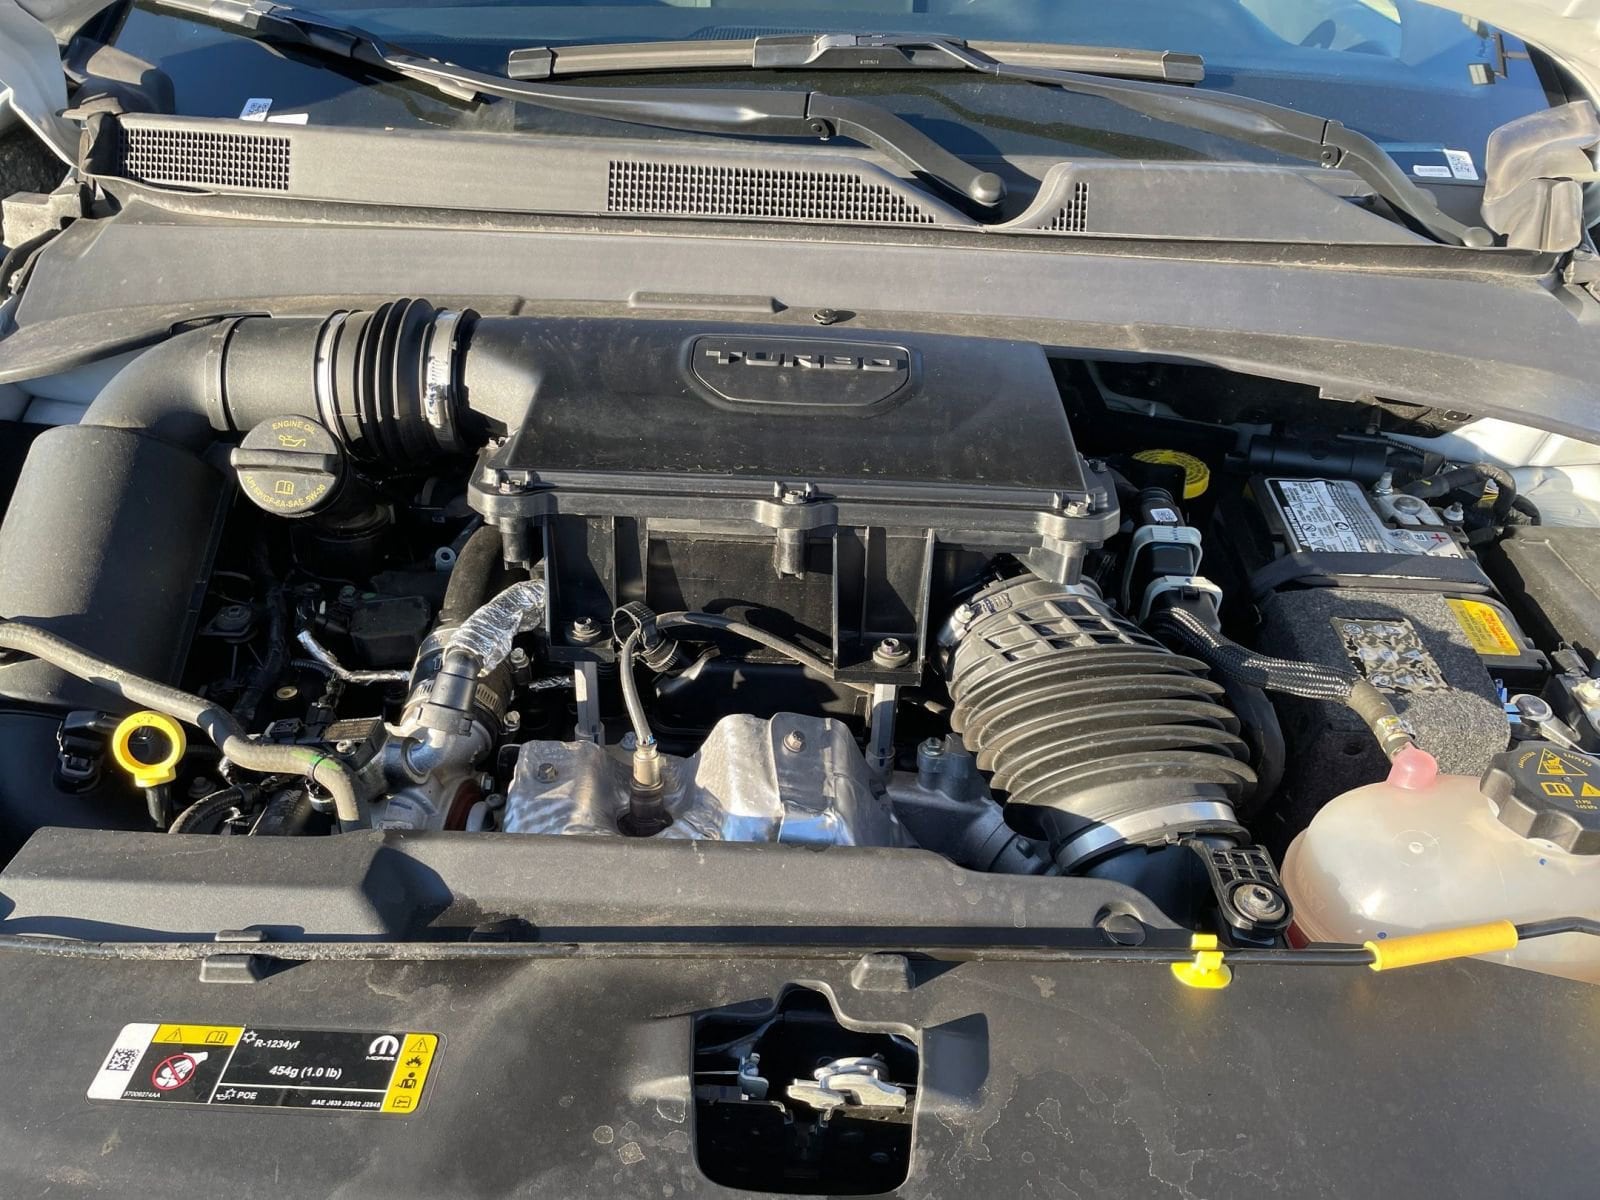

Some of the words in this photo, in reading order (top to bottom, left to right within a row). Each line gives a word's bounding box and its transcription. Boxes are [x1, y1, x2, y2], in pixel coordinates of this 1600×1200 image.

[272, 420, 302, 430] ENGINE
[303, 423, 317, 434] OIL
[254, 1038, 300, 1049] R-1234yf
[269, 1065, 298, 1079] 454g
[300, 1065, 322, 1079] (1.0
[325, 1066, 343, 1079] lb)
[236, 1091, 257, 1100] POE
